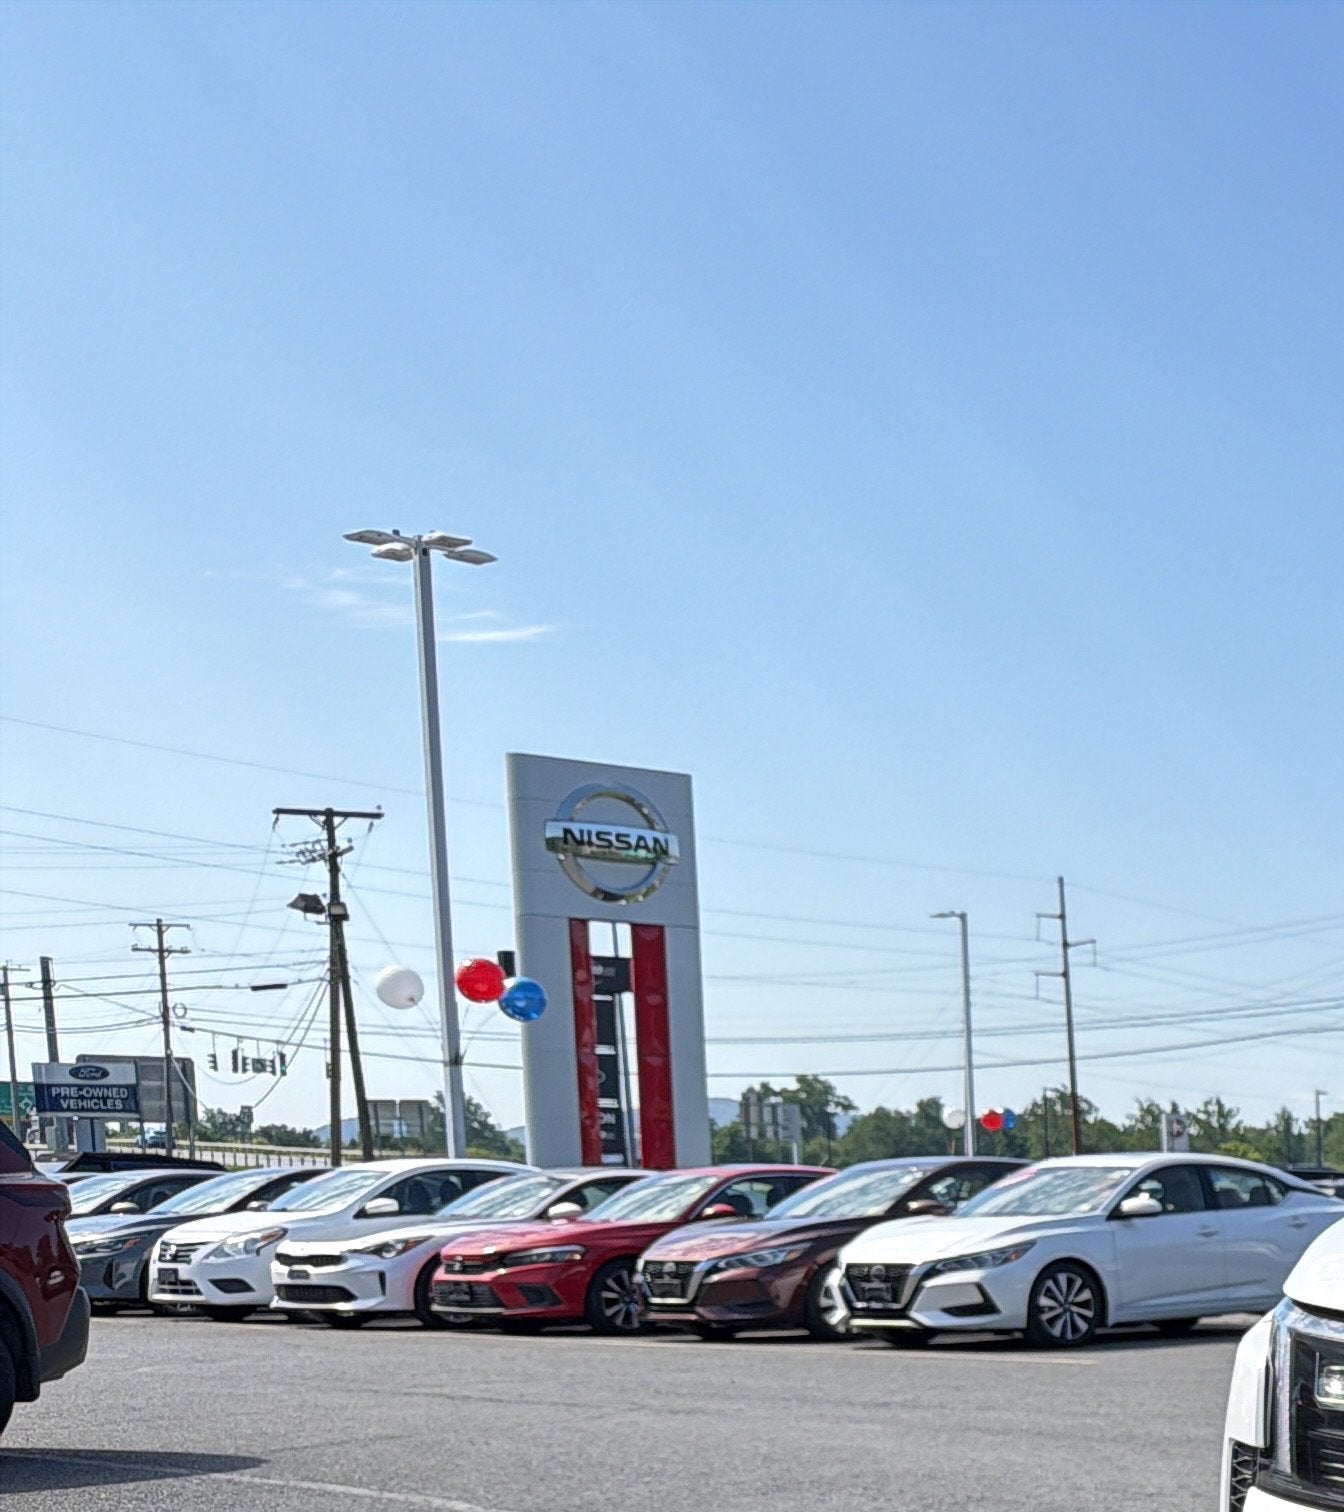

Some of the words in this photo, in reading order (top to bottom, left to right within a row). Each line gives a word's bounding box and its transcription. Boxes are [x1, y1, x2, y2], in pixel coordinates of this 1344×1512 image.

[562, 827, 670, 856] NISSAN
[51, 1086, 128, 1098] PRE-OWNED
[60, 1099, 124, 1110] VEHICLES
